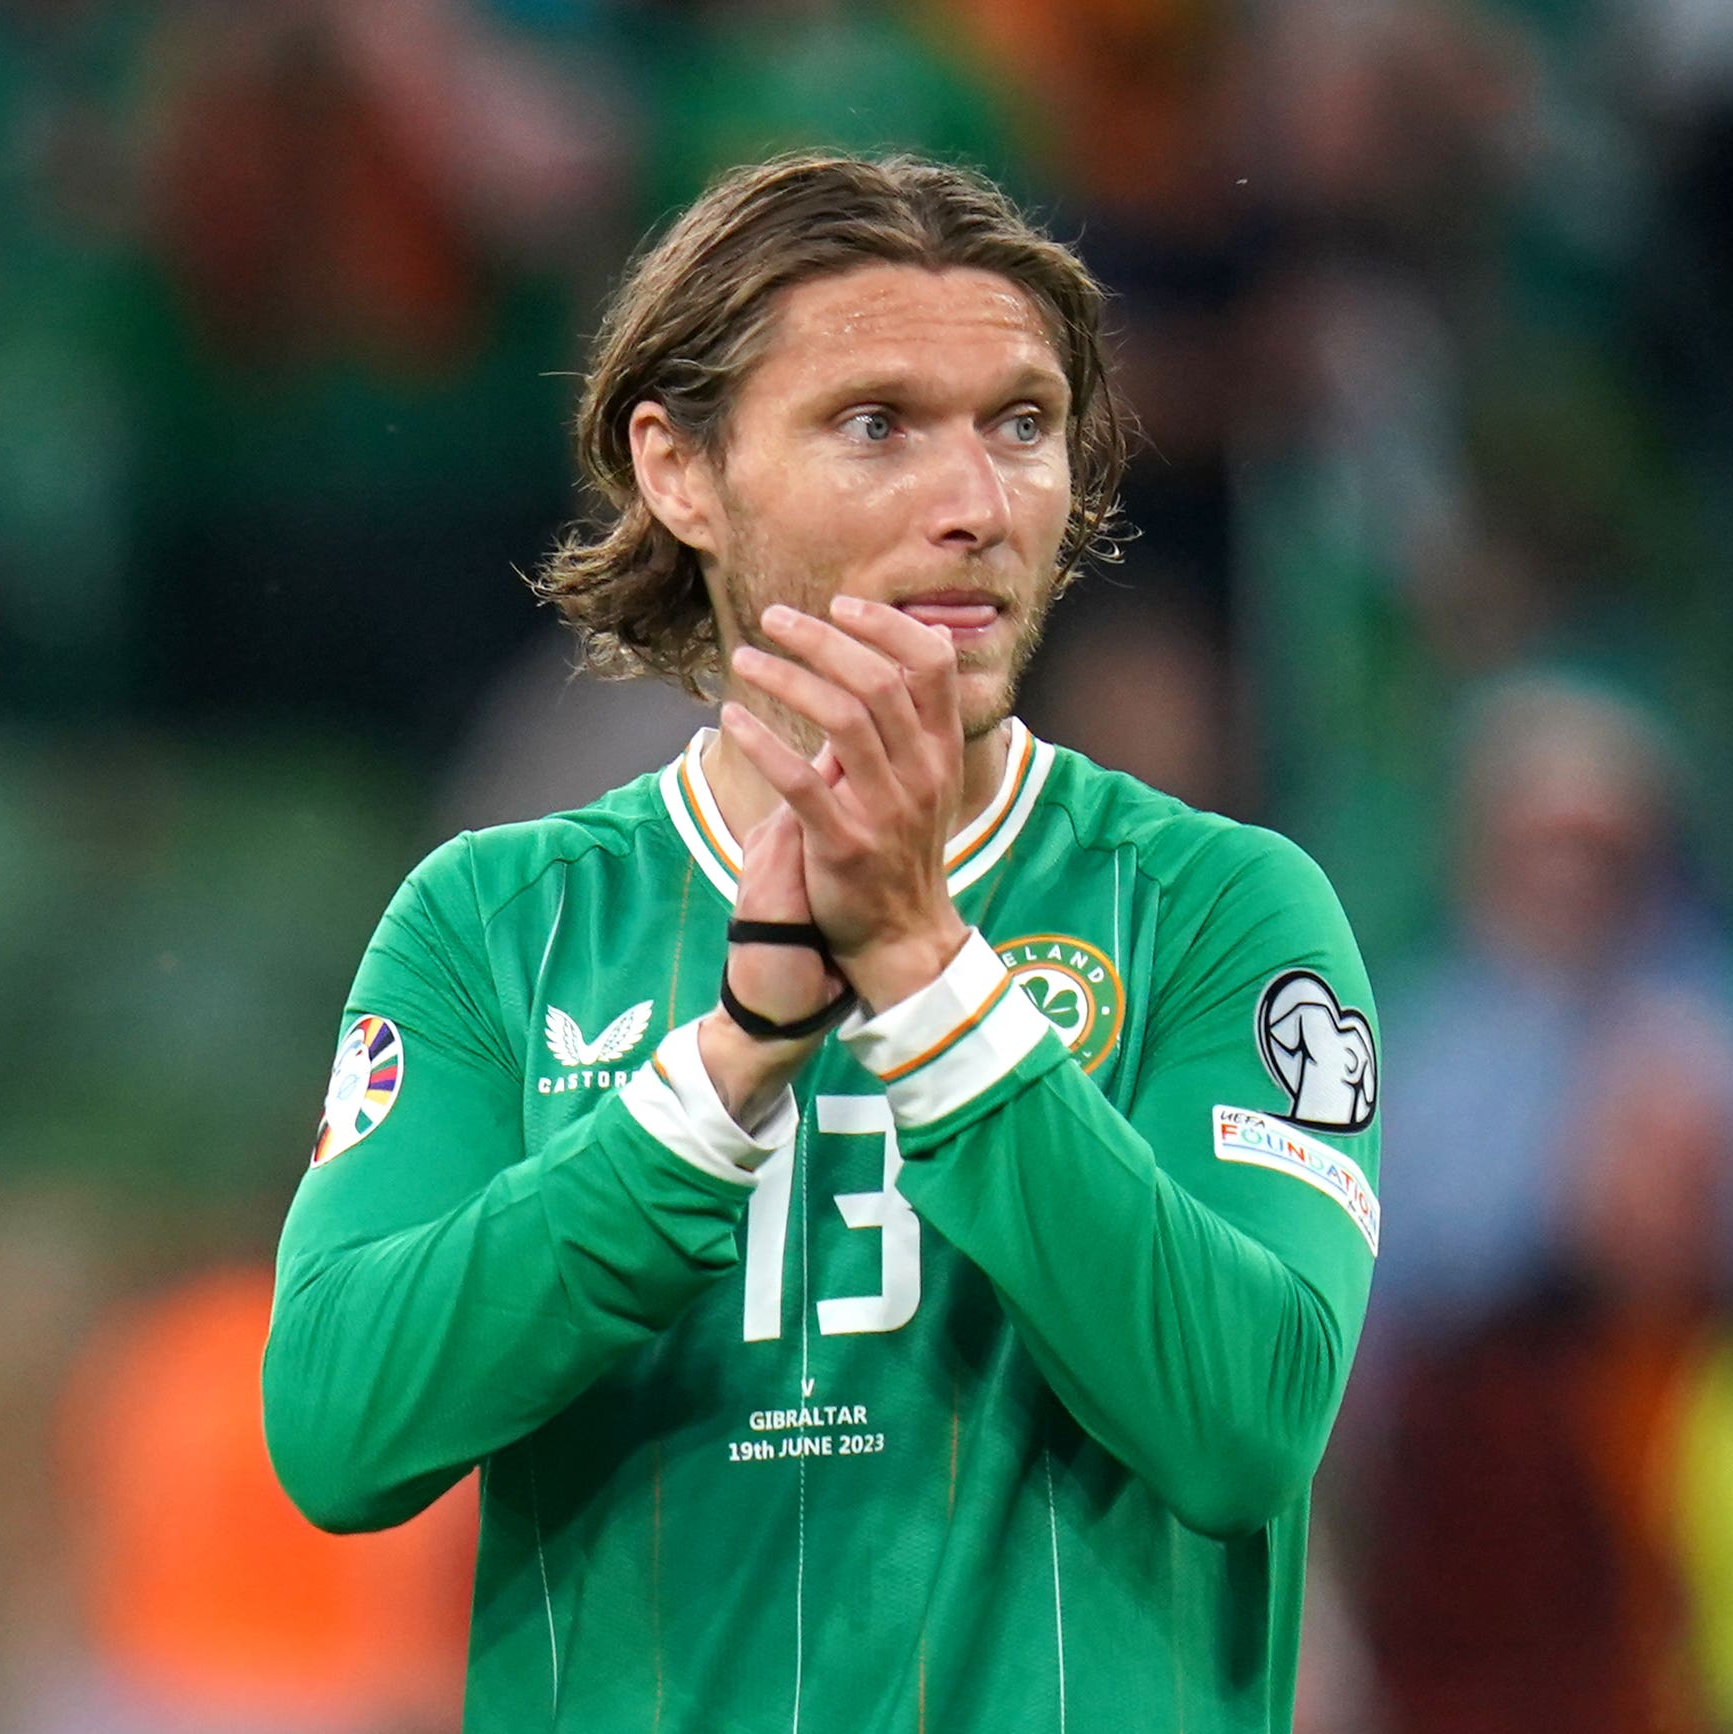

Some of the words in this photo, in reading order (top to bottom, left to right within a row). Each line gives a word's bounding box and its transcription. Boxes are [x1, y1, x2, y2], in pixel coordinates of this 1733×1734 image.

[1000, 944, 1105, 983] ELAND
[1220, 1111, 1265, 1127] UEFA
[744, 1095, 920, 1342] 13
[801, 1378, 815, 1397] V
[749, 1405, 868, 1431] GIBRALTAR
[728, 1439, 775, 1461] 19th
[778, 1435, 833, 1457] JUNE
[838, 1433, 885, 1455] 2023
